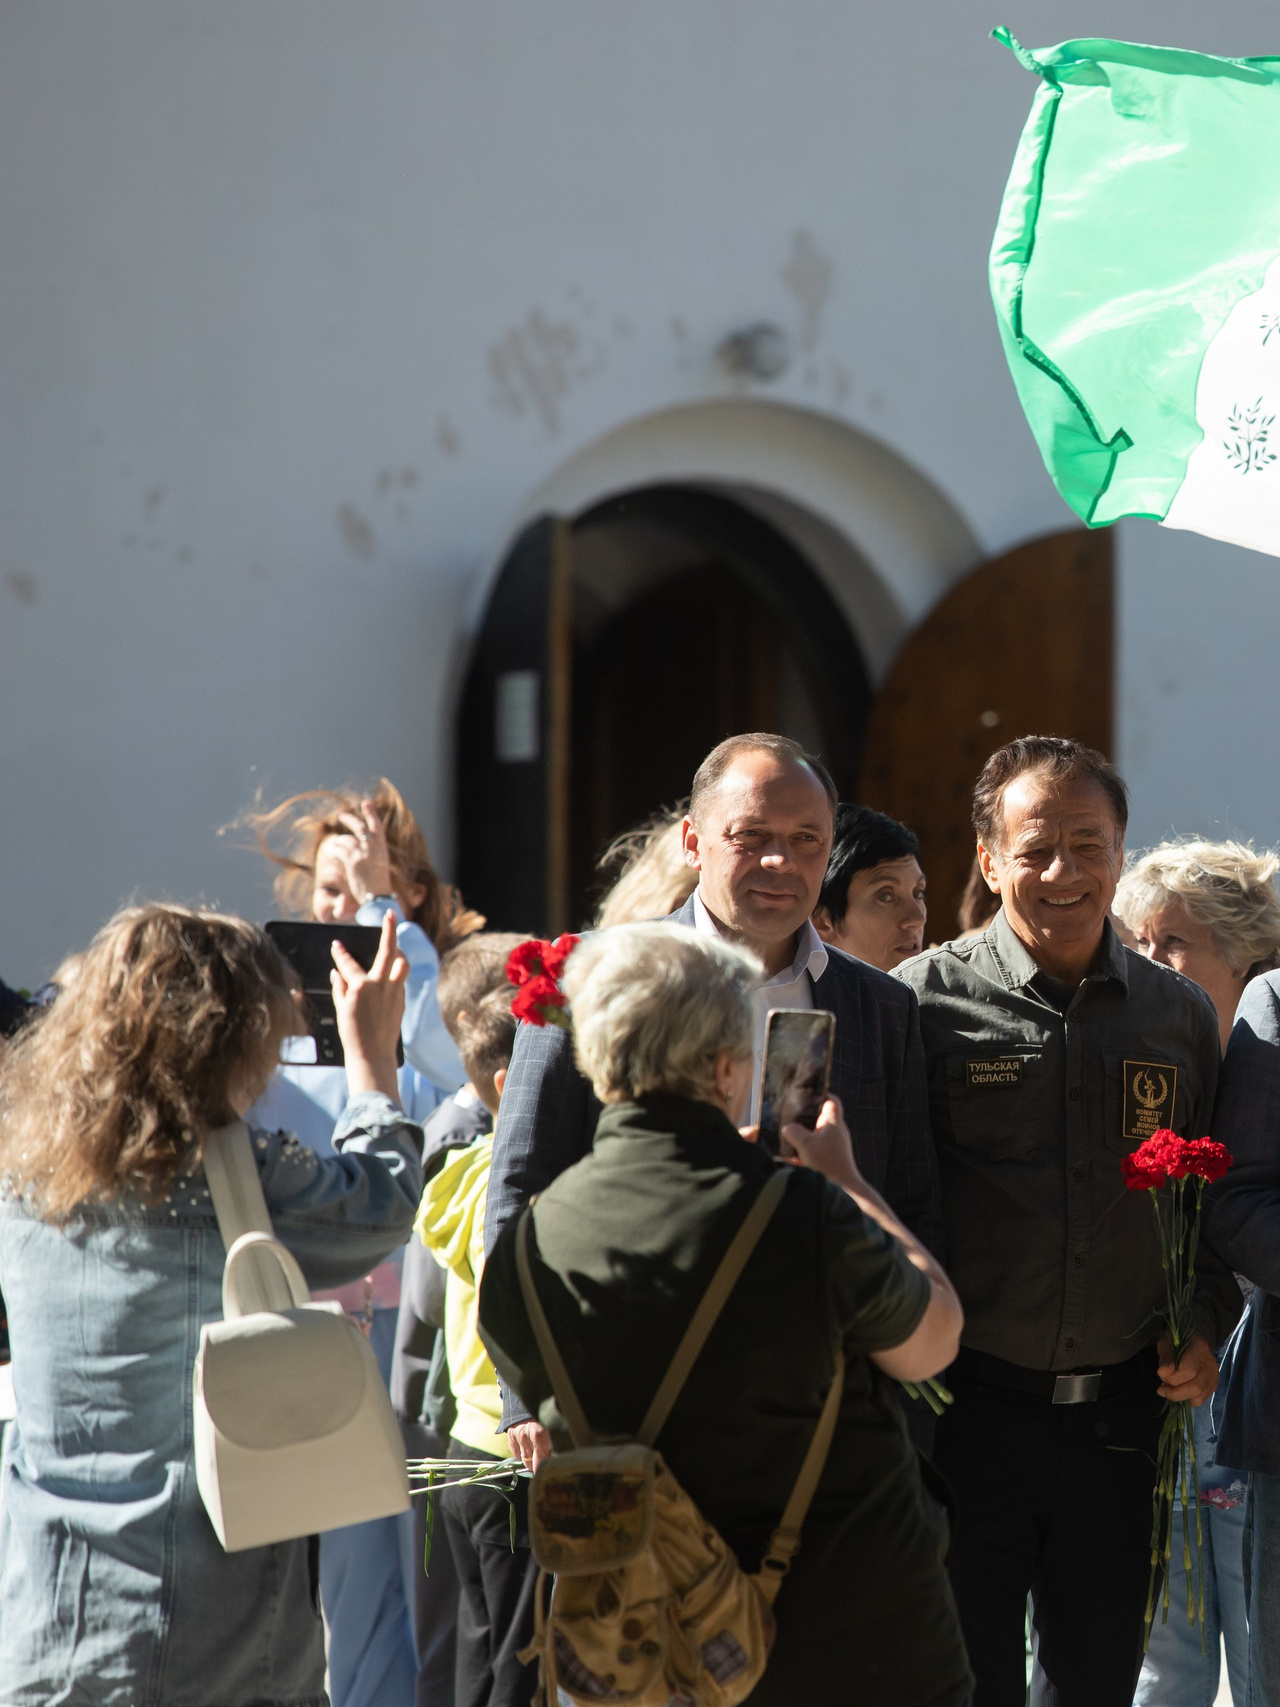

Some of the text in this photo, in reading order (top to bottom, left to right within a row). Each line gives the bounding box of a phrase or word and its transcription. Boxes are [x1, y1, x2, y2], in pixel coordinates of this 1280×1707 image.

[969, 1061, 1020, 1072] ТУЛЬСКАЯ
[971, 1073, 1018, 1083] ОБЛАСТЬ
[1135, 1109, 1163, 1118] КОМИТЕТ
